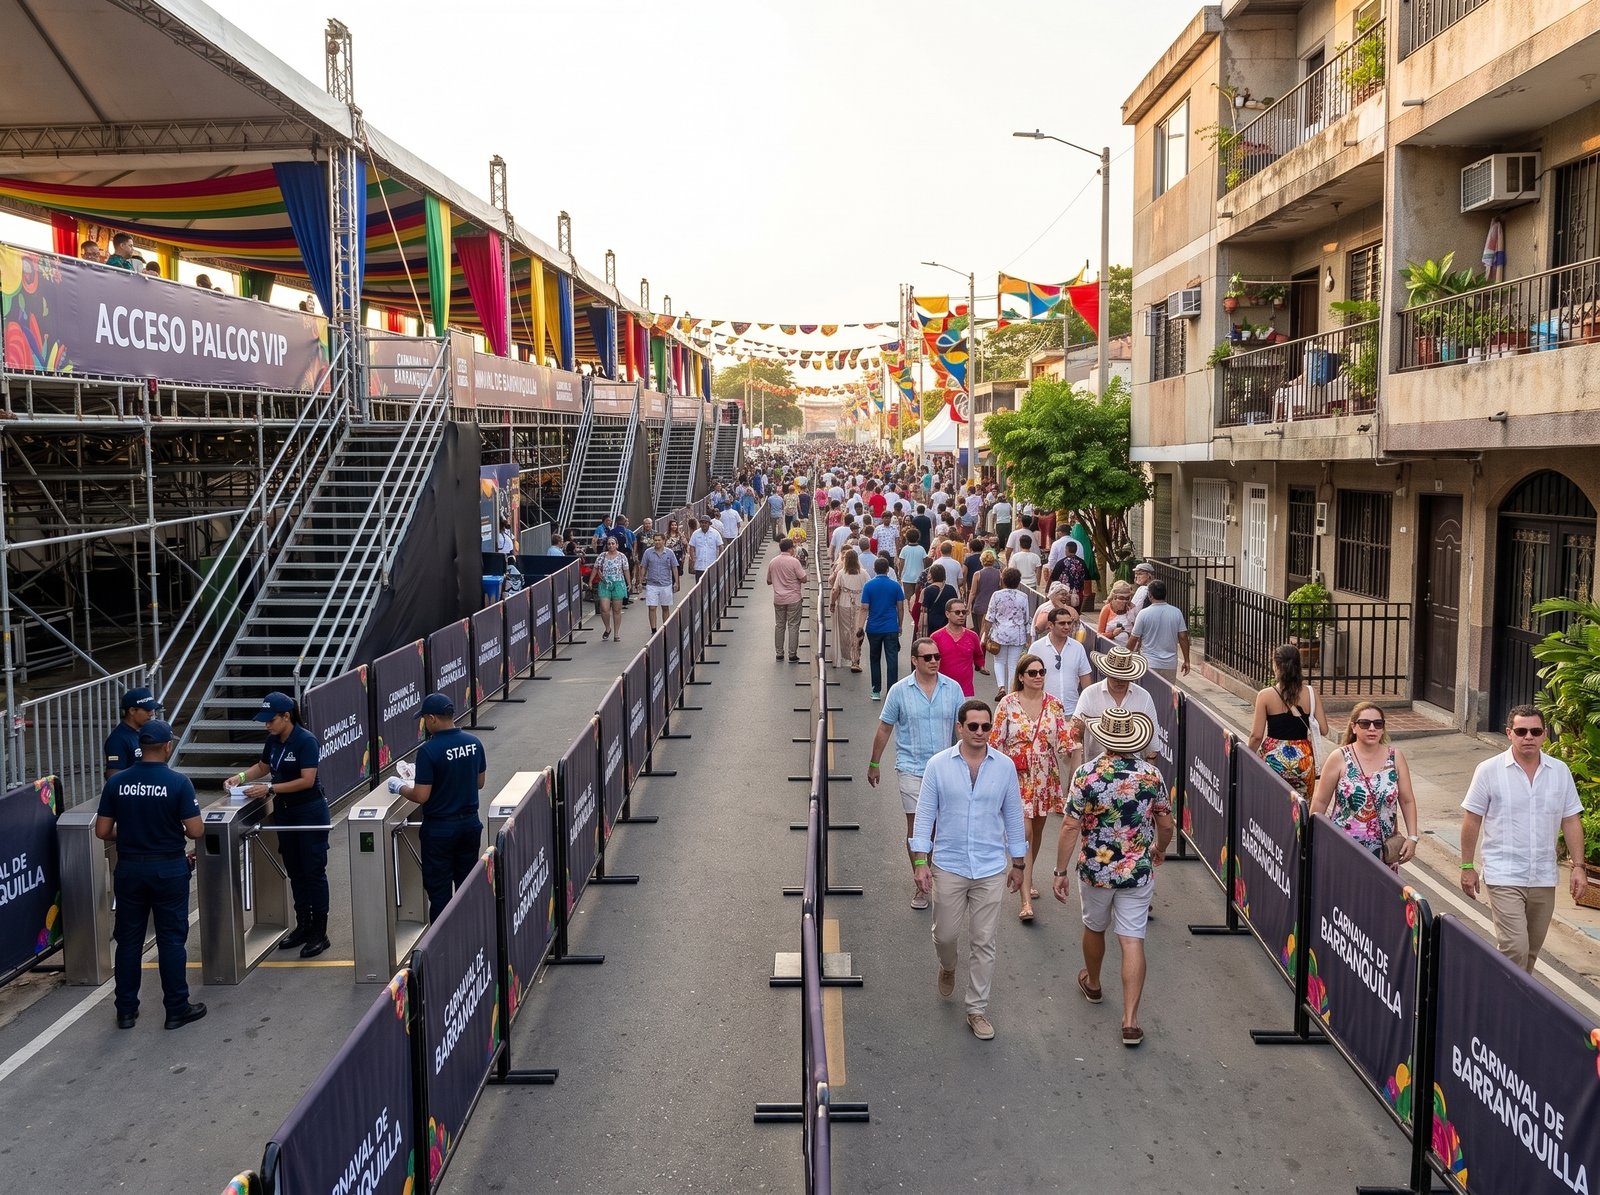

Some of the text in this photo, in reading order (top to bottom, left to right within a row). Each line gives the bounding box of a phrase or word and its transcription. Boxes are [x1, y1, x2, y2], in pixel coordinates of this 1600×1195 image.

[95, 302, 288, 366] ACCESO PALCOS VIP
[349, 714, 356, 726] DE
[446, 744, 477, 760] STAFF
[119, 782, 167, 797] LOGÍSTICA
[12, 852, 27, 874] DE
[1242, 828, 1290, 899] BARRANQUILLA
[1275, 844, 1283, 865] DE
[1321, 916, 1402, 1020] BARRANQUILLA
[1333, 906, 1388, 975] CARNAVAL DE
[435, 960, 492, 1075] BARRANQUILLA
[444, 947, 484, 1027] CARNAVAL DE
[1452, 1045, 1588, 1195] BARRANQUILLA
[1471, 1036, 1565, 1140] CARNAVAL DE
[376, 1106, 388, 1143] DE
